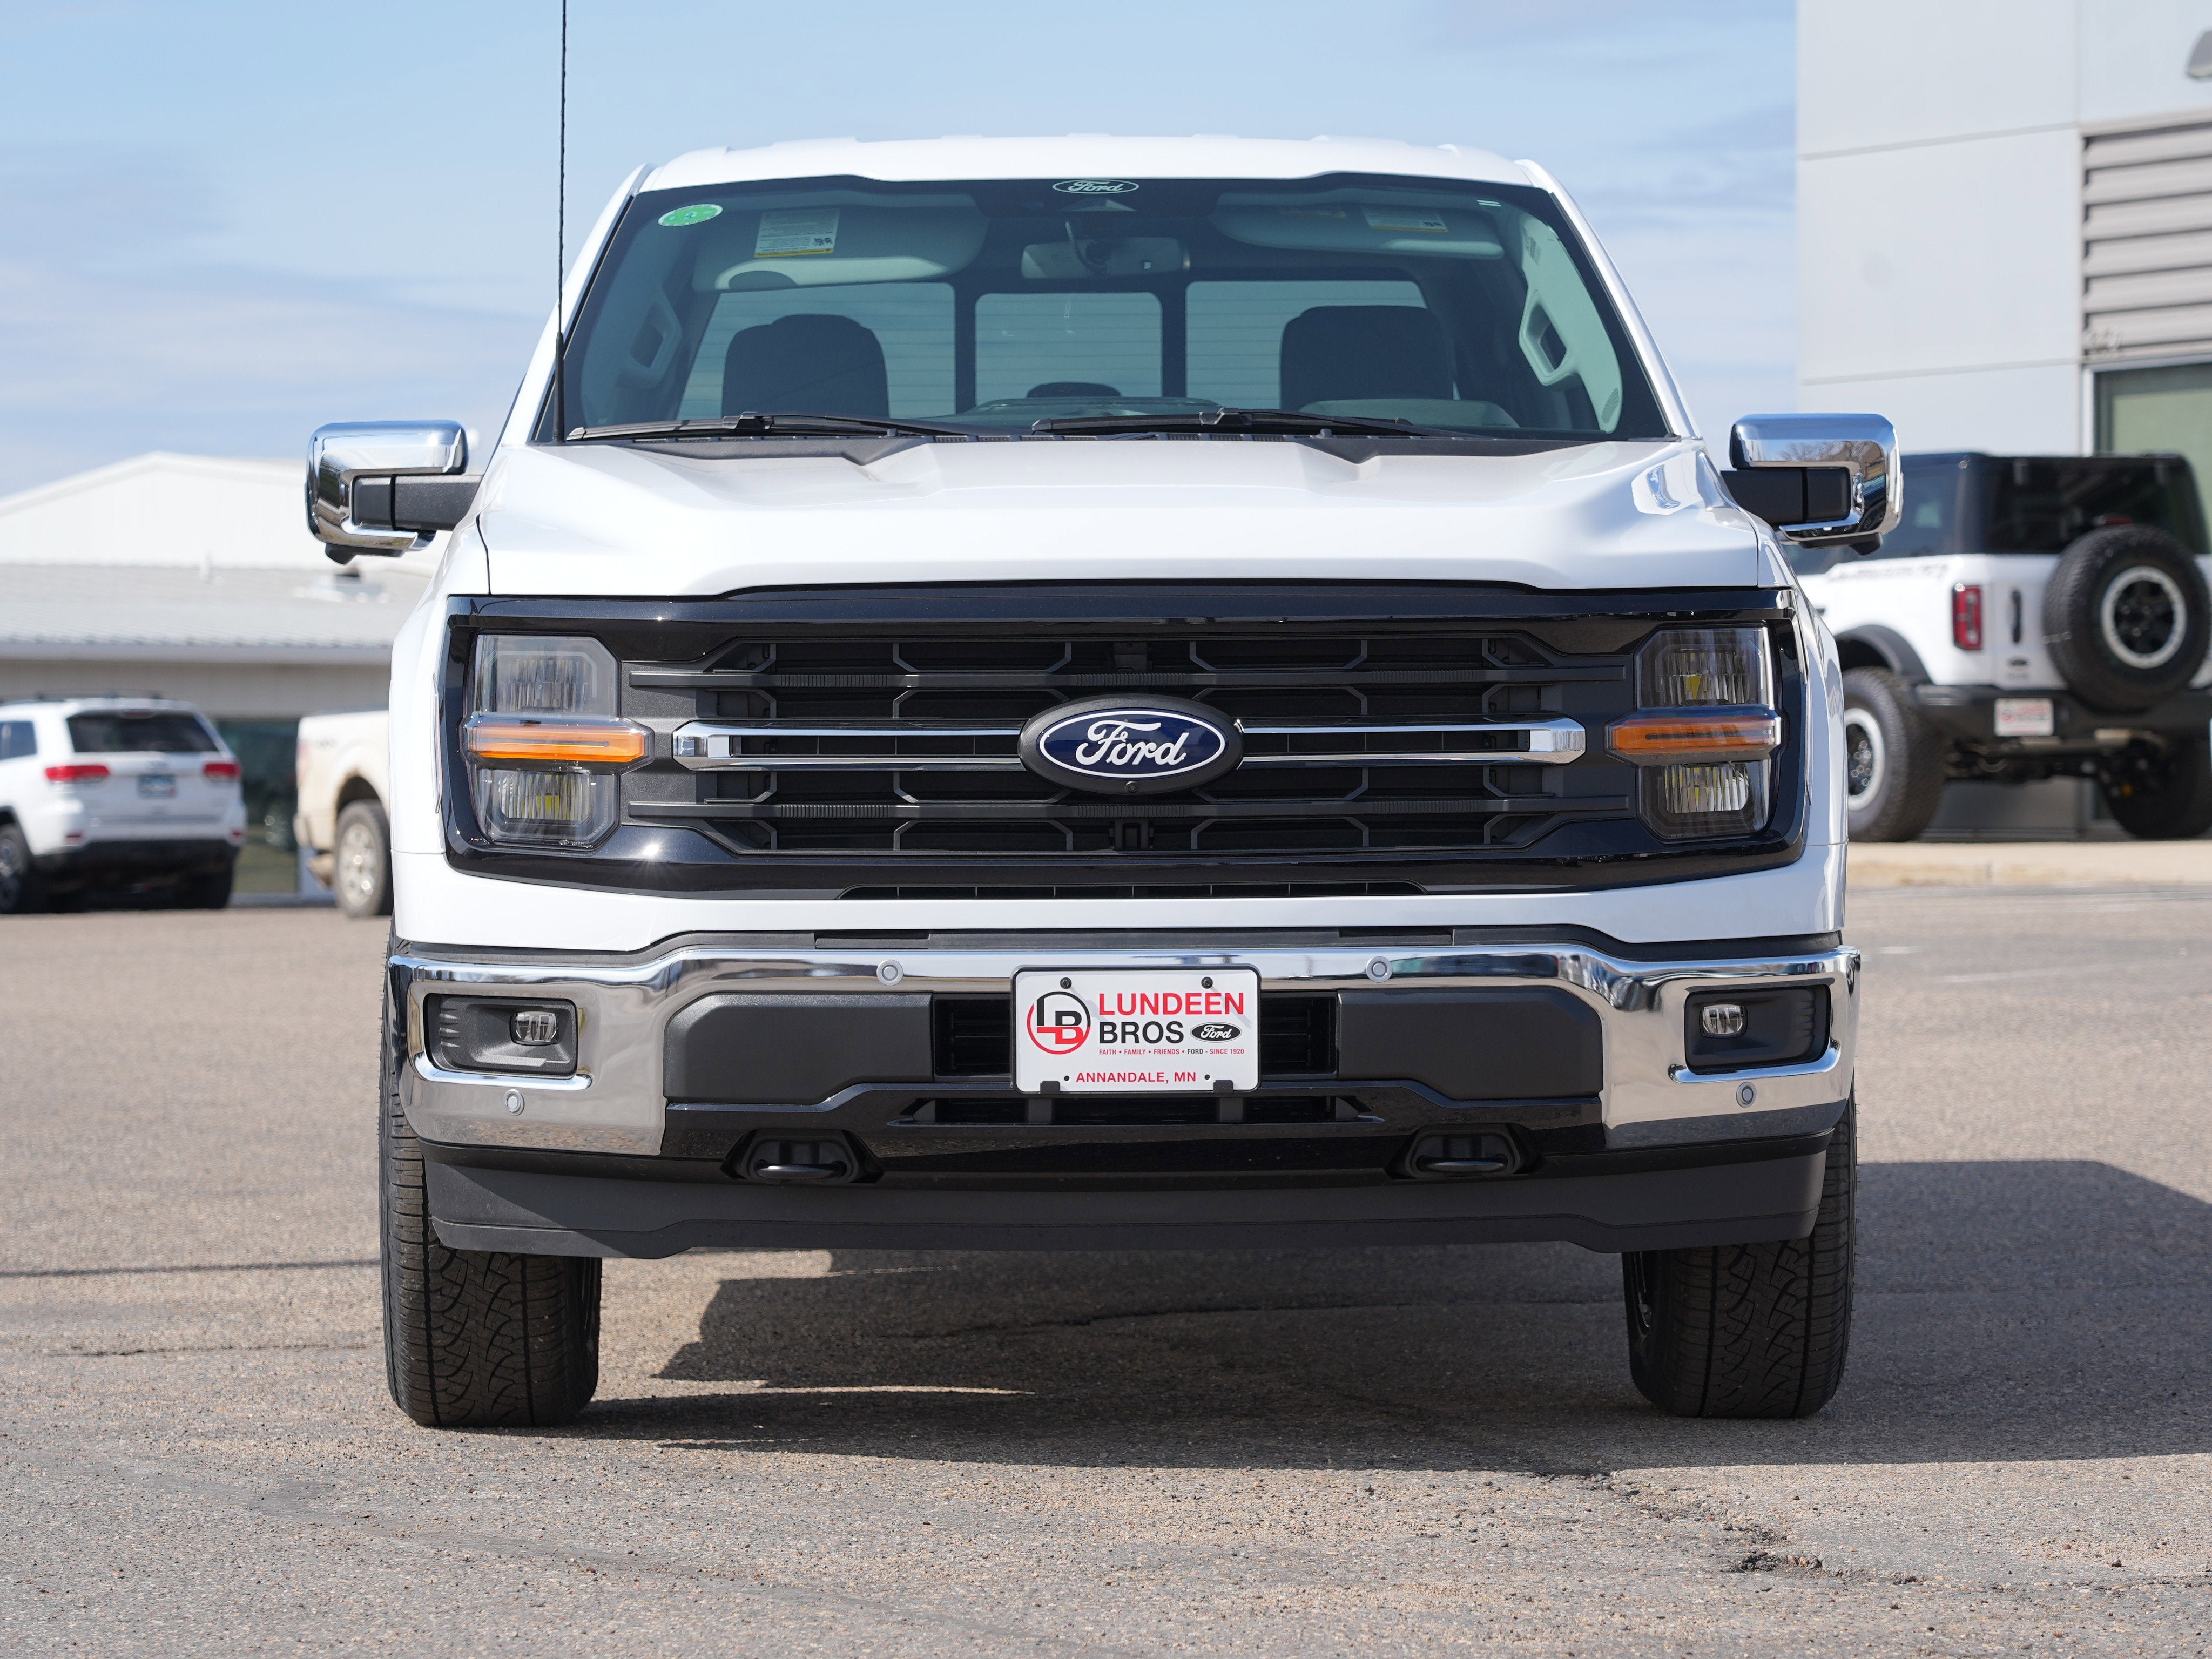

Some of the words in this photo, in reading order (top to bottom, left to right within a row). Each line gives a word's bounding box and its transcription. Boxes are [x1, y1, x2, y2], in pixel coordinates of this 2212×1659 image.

[1067, 181, 1124, 192] Ford
[1075, 720, 1190, 766] Ford
[1099, 992, 1244, 1015] LUNDEEN
[1099, 1021, 1185, 1044] BROS
[1200, 1025, 1233, 1039] Ford
[1076, 1072, 1169, 1084] ANNANDALE,
[1174, 1071, 1196, 1082] MN
